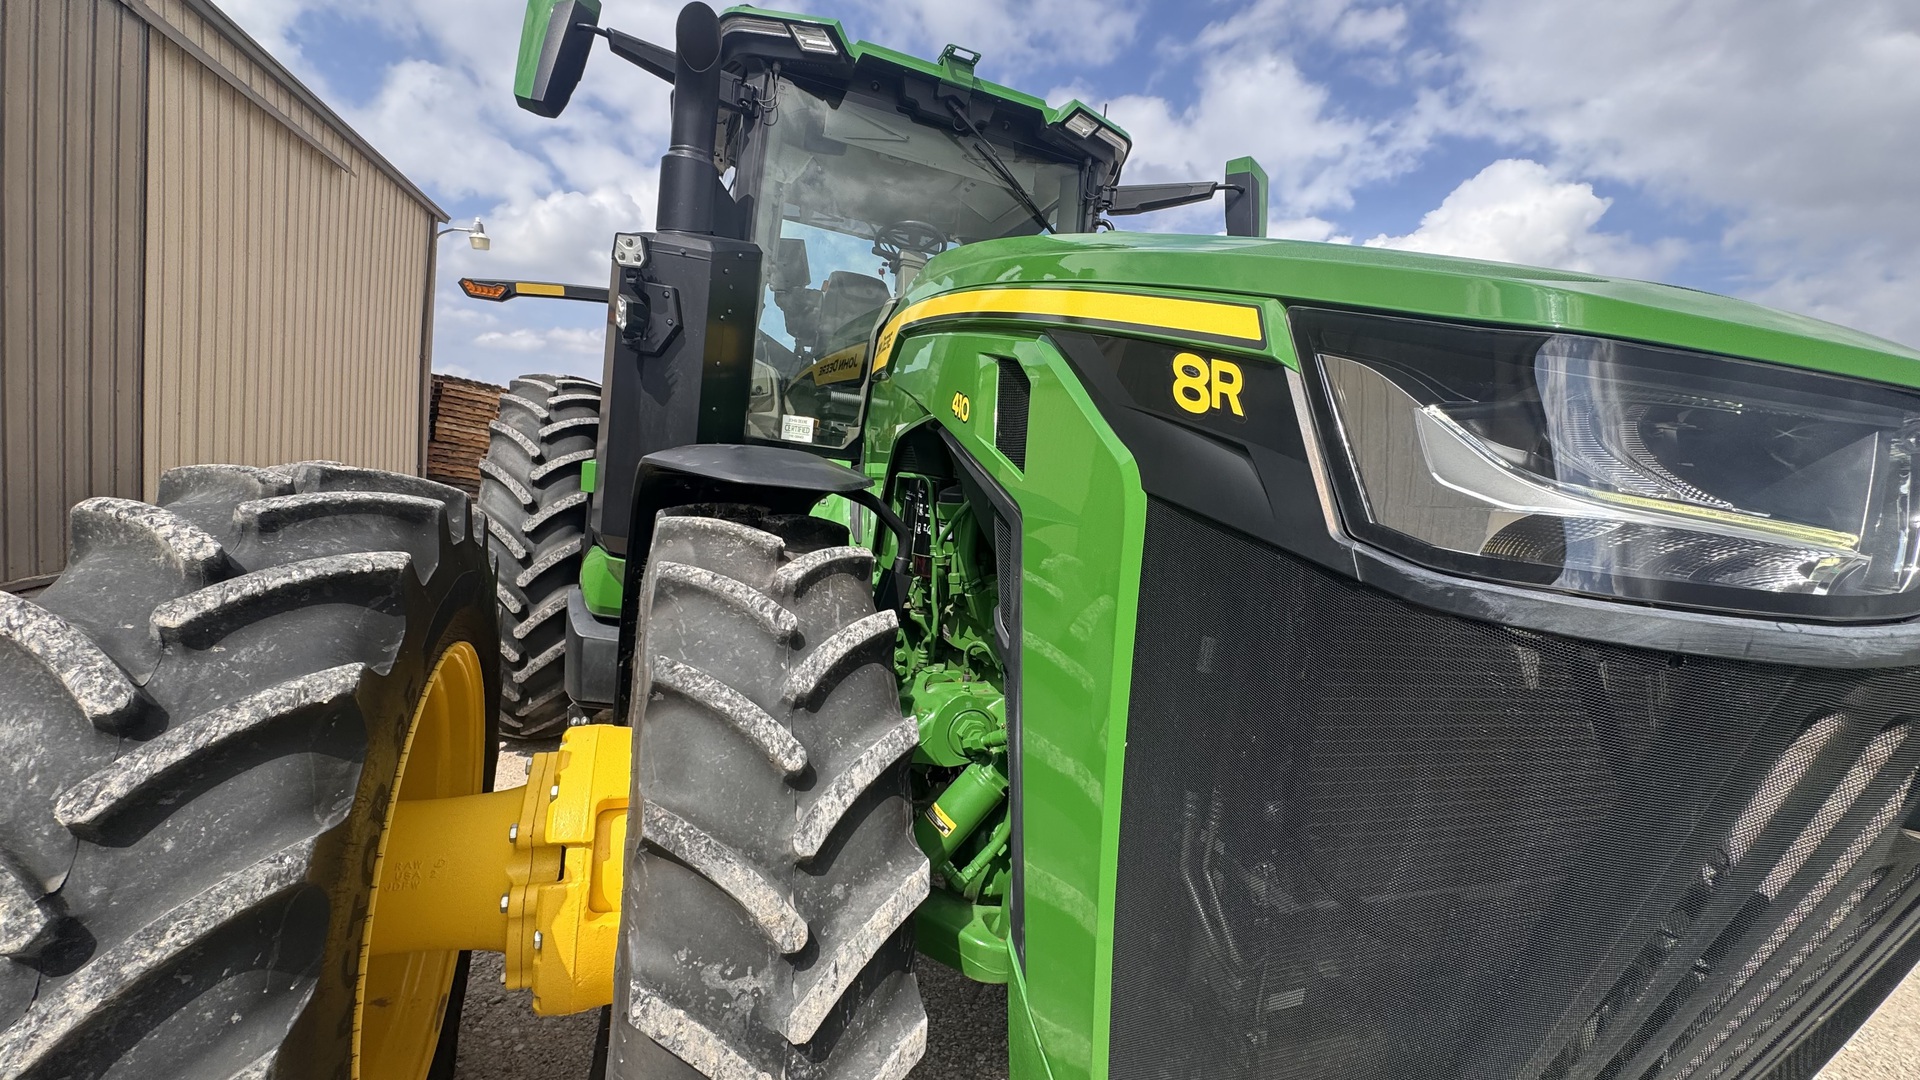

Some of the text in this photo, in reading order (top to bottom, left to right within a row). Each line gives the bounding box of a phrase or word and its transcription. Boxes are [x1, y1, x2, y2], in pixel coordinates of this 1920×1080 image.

[1171, 352, 1245, 417] 8R
[951, 391, 970, 423] 410
[394, 870, 421, 880] USA
